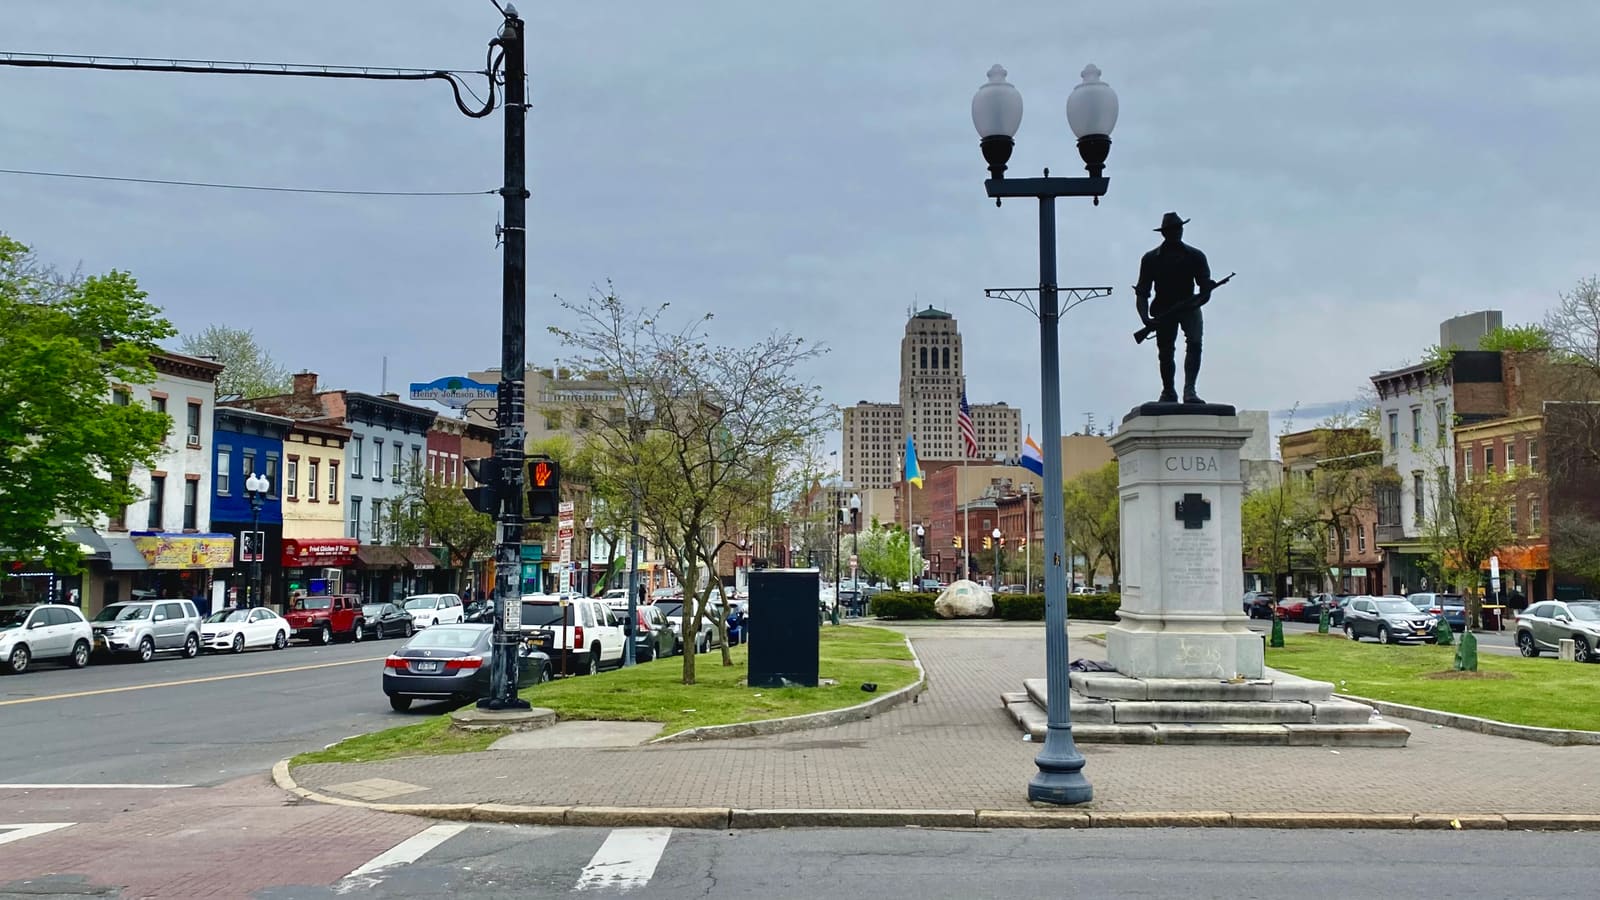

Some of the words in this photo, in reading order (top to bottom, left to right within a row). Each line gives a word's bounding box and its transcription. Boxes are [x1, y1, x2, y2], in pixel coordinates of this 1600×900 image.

[413, 389, 438, 399] Henry
[441, 389, 474, 399] Johnson
[477, 390, 496, 398] Blvd
[1165, 456, 1218, 472] CUBA
